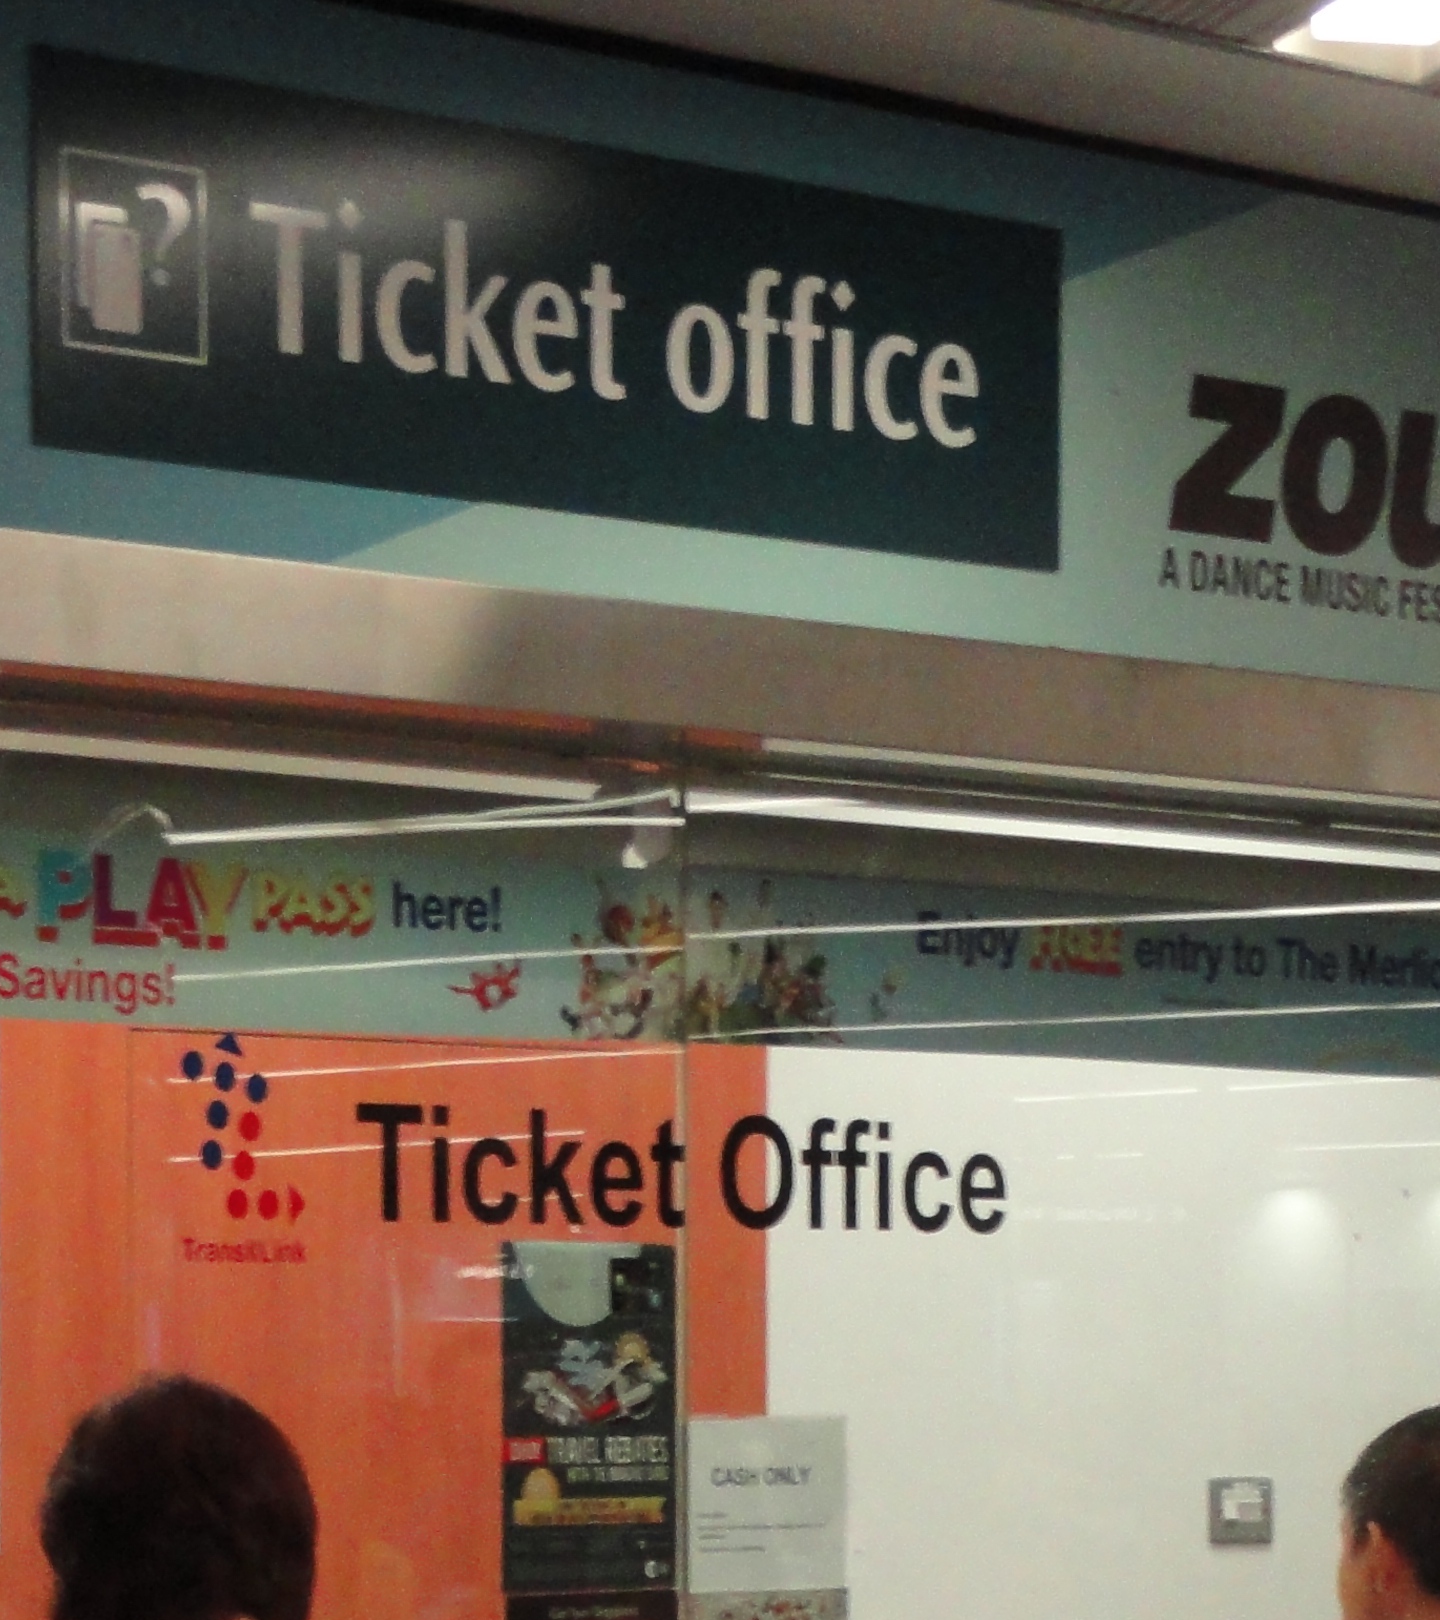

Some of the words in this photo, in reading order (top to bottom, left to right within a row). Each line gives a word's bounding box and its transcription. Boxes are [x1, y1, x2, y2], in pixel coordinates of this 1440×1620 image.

[248, 200, 626, 401] Ticket
[666, 267, 980, 448] office
[1158, 546, 1181, 591] A
[1189, 549, 1292, 603] DANCE
[1298, 563, 1390, 618] MUSIC
[36, 848, 250, 951] PLAY
[392, 880, 503, 934] here!
[915, 909, 1021, 971] Enjoy
[1133, 934, 1224, 984] entry
[1232, 936, 1267, 978] to
[1275, 936, 1339, 985] The
[355, 1103, 686, 1229] Ticket
[720, 1113, 1009, 1234] Office
